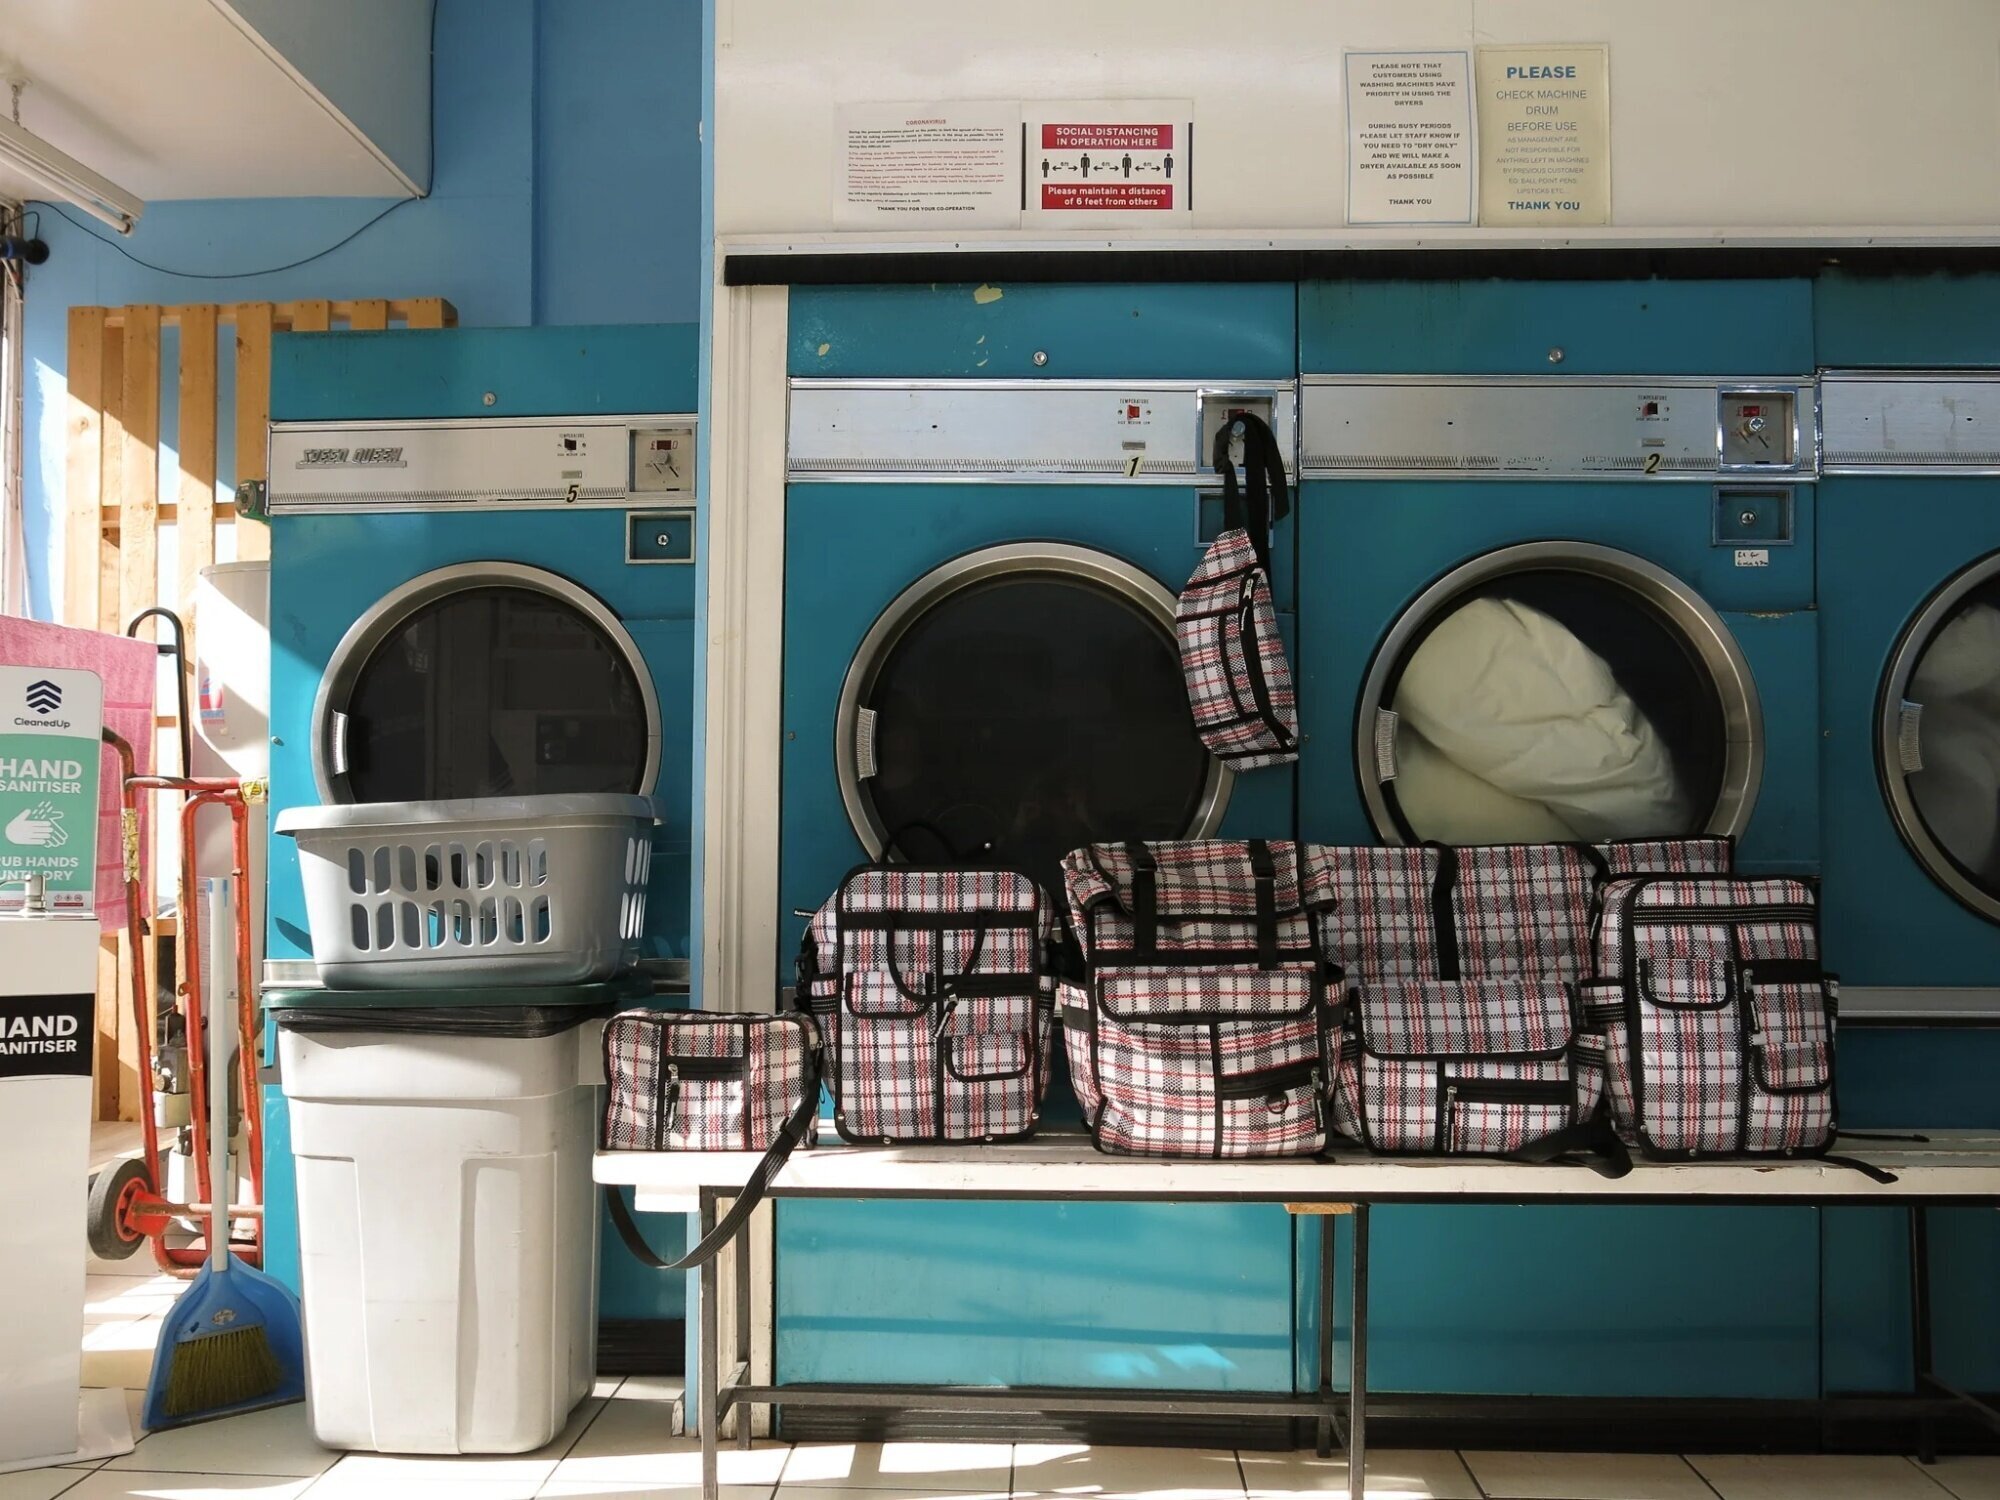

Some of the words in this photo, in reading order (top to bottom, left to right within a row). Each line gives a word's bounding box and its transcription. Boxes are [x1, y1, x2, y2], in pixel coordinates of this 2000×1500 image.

[1507, 66, 1576, 78] PLEASE
[1496, 90, 1534, 99] CHECK
[1537, 90, 1587, 99] MACHINE
[1526, 106, 1558, 115] DRUM
[1056, 128, 1093, 136] SOCIAL
[1096, 128, 1158, 136] DISTANCING
[1507, 122, 1552, 131] BEFORE
[1555, 122, 1578, 131] USE
[1048, 187, 1076, 195] Please
[1080, 187, 1118, 195] maintain
[1121, 187, 1126, 195] a
[1128, 187, 1166, 195] distance
[1064, 197, 1073, 205] of
[1076, 197, 1082, 205] 6
[1085, 197, 1102, 205] feet
[1105, 197, 1126, 205] from
[1129, 197, 1158, 205] others
[1509, 202, 1550, 210] THANK
[1556, 202, 1580, 210] YOU
[1130, 457, 1139, 476] 1
[1645, 453, 1660, 473] 2
[566, 485, 578, 502] 5
[14, 718, 70, 729] CleanedUp
[0, 758, 82, 779] HAND
[0, 780, 81, 793] SANITISER
[26, 856, 79, 868] HANDS
[44, 871, 74, 881] DRY
[0, 1040, 77, 1054] ANITISER
